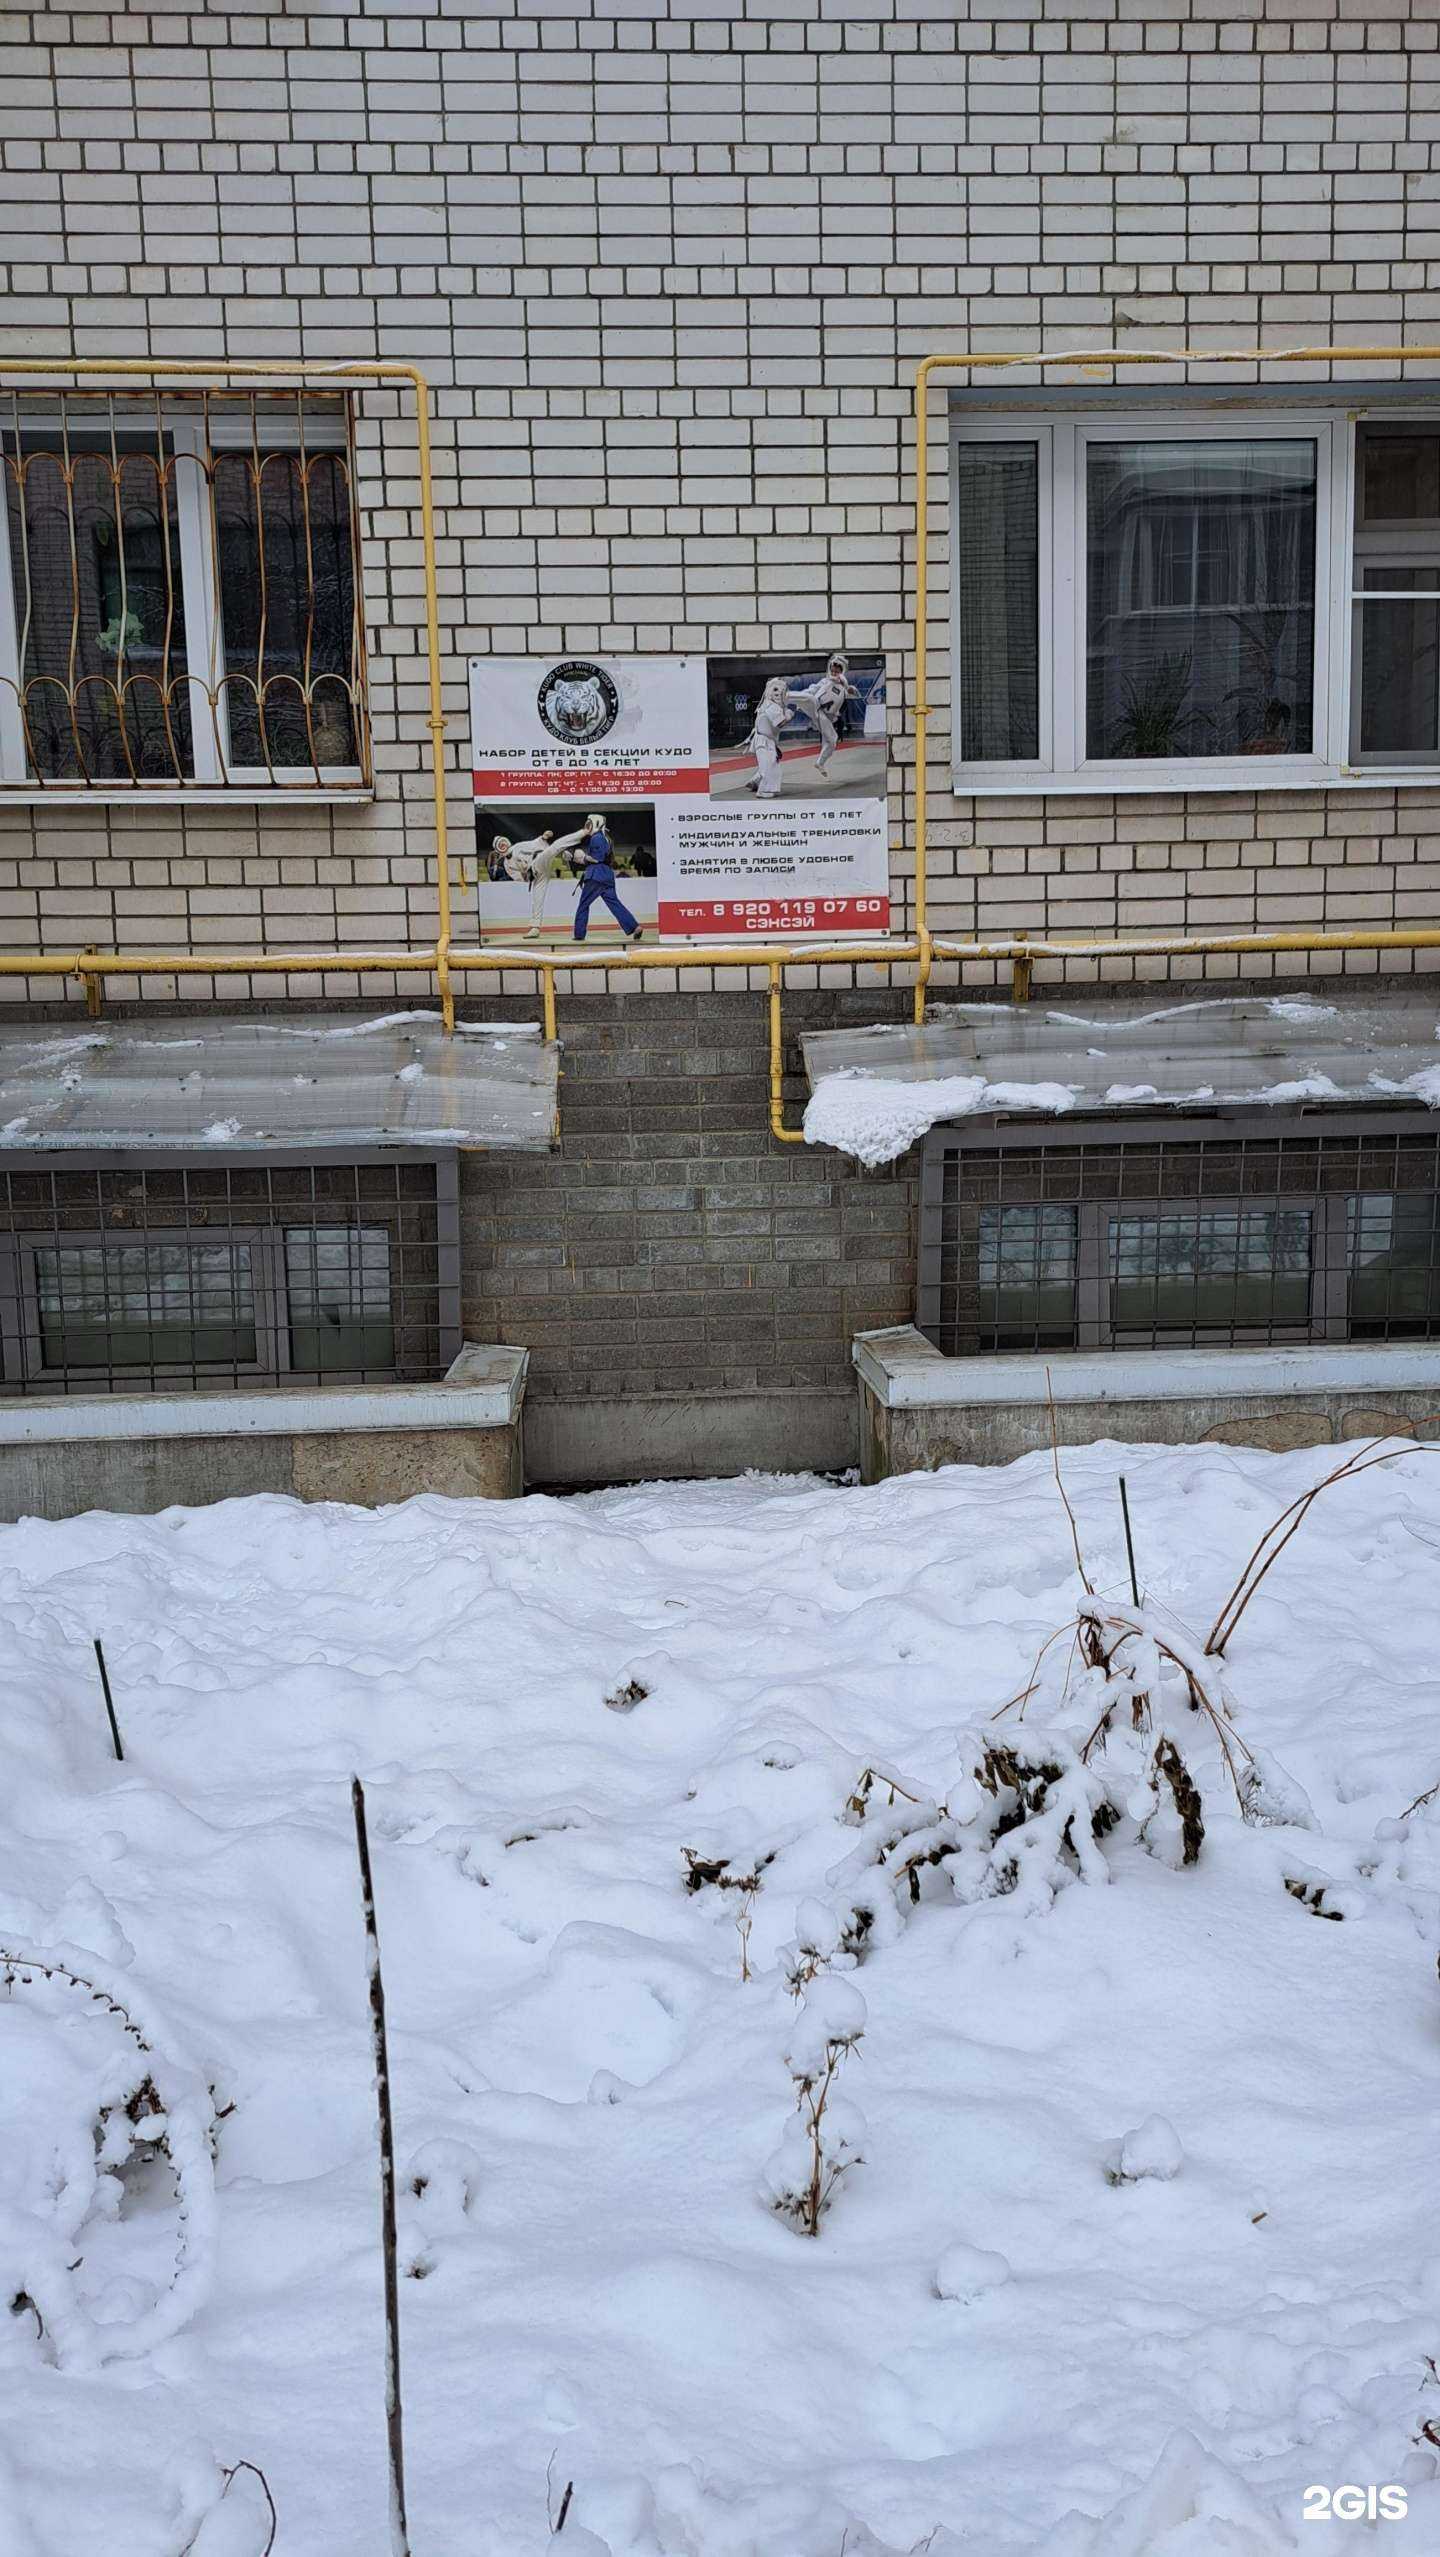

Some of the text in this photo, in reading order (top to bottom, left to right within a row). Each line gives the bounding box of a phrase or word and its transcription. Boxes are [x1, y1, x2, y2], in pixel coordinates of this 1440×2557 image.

[555, 663, 574, 674] CLUB
[479, 746, 693, 758] НАБОР ДЕТЕЙ В СЕКЦИИ КУДО
[532, 757, 641, 768] ОТ 6 ДО 14 ЛЕТ
[508, 771, 545, 779] ГРУППА:
[508, 780, 545, 789] ГРУППА:
[678, 813, 743, 822] ВЗРОСЛЫЕ
[747, 812, 797, 821] ГРУППЫ
[800, 811, 817, 820] ОТ
[839, 810, 863, 819] ЛЕТ
[678, 828, 882, 840] ИНДИВИДУАЛЬНЫЕ ТРЕНИРОВКИ
[679, 839, 808, 849] МУЖЧИН И ЖЕНЩИН
[679, 855, 854, 867] ЗАНЯТИЯ В ЛЮБОЕ УДОБНОЕ
[680, 865, 796, 875] ВРЕМЯ ПО ЗАПИСИ
[678, 900, 882, 917] ТЕЛ. 8 920 119 07 60
[746, 914, 815, 930] СЭНСЭЙ
